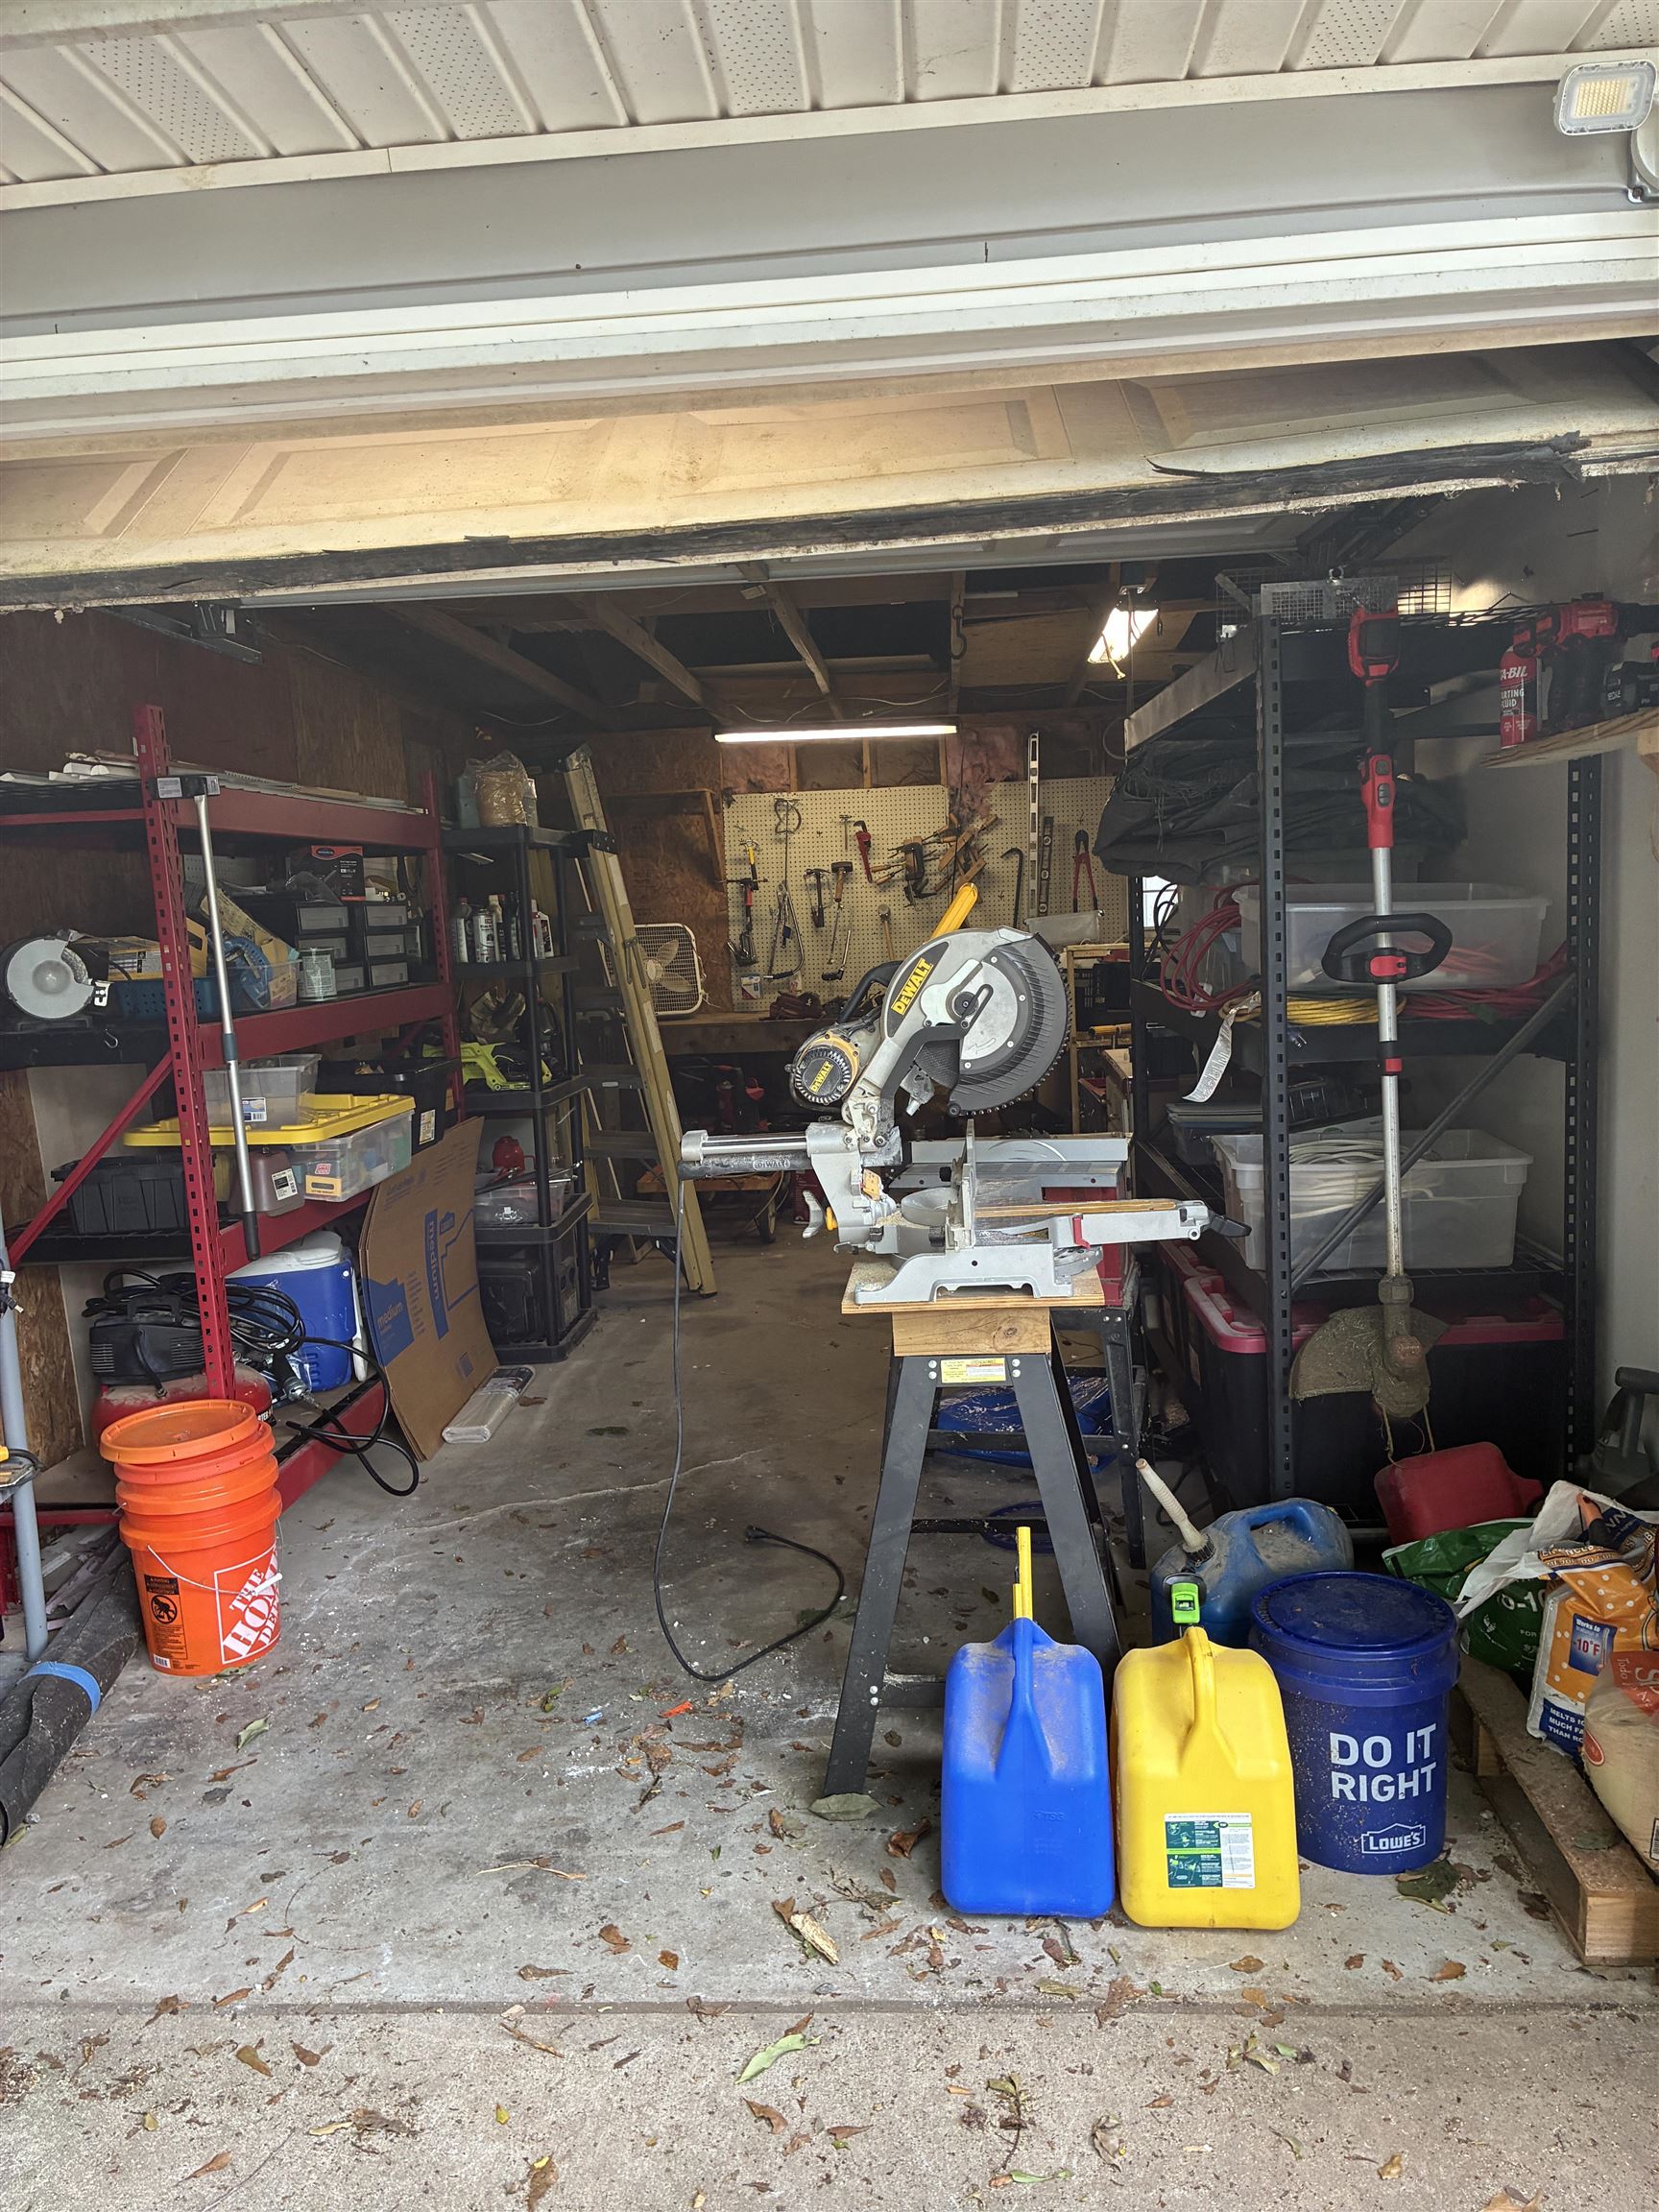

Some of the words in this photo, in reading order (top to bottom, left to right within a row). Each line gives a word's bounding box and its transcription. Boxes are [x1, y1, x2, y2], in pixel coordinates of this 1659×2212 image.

[377, 1301, 403, 1326] medium
[228, 1568, 264, 1612] THE
[1575, 1619, 1593, 1630] Works
[1549, 1717, 1573, 1732] MUCH
[1550, 1707, 1576, 1724] MELTS
[1548, 1725, 1571, 1740] THAN
[1330, 1732, 1392, 1768] DO
[1407, 1723, 1437, 1764] IT
[1331, 1762, 1437, 1802] RIGHT
[1369, 1832, 1421, 1851] LOWE'S
